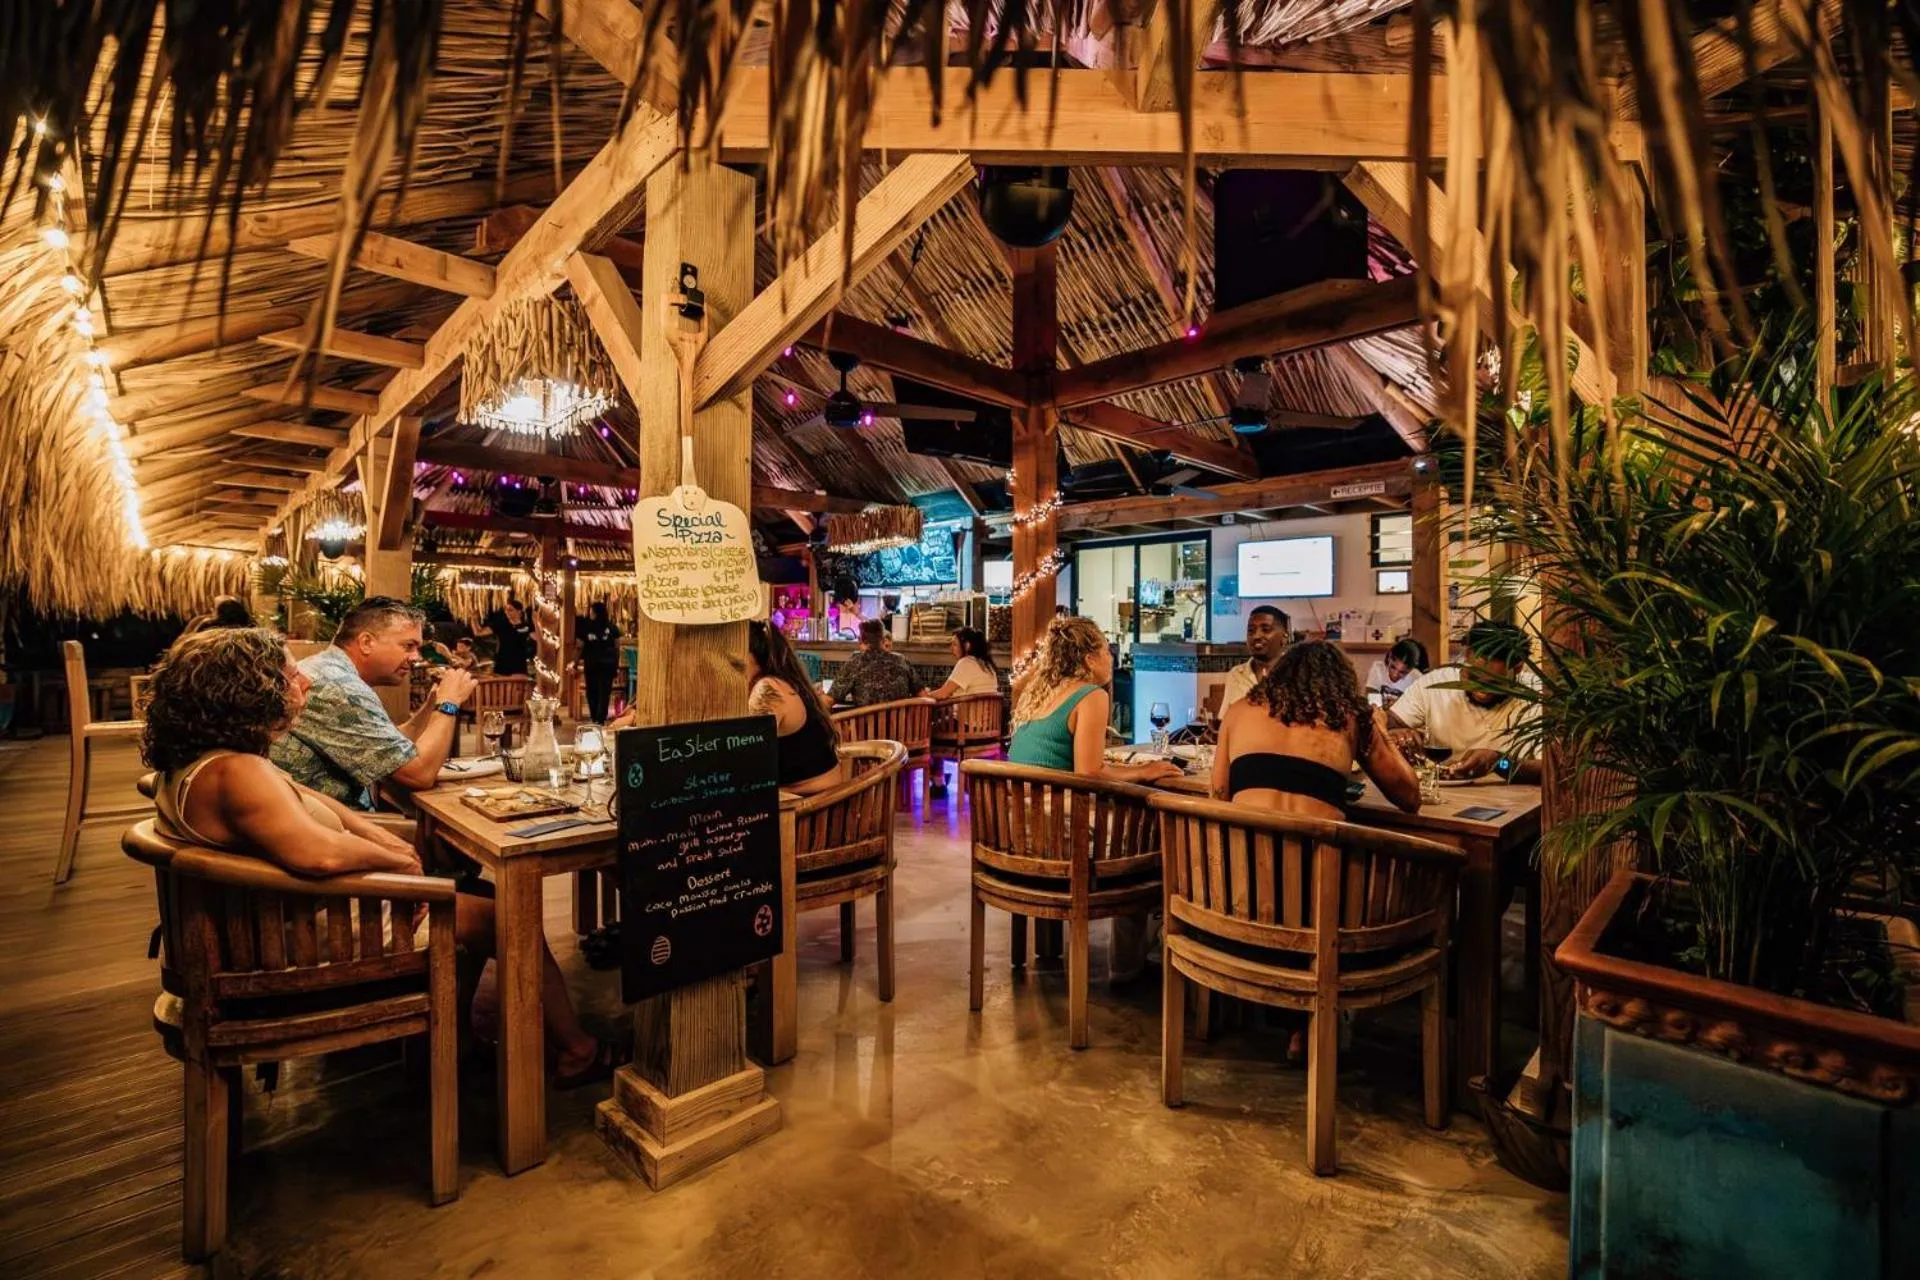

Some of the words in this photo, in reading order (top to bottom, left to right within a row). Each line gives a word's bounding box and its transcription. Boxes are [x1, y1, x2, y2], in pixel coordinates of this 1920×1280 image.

[1341, 483, 1383, 495] RECEPTIE
[657, 508, 726, 534] Special
[678, 529, 723, 544] Pizza
[657, 734, 721, 762] Easter
